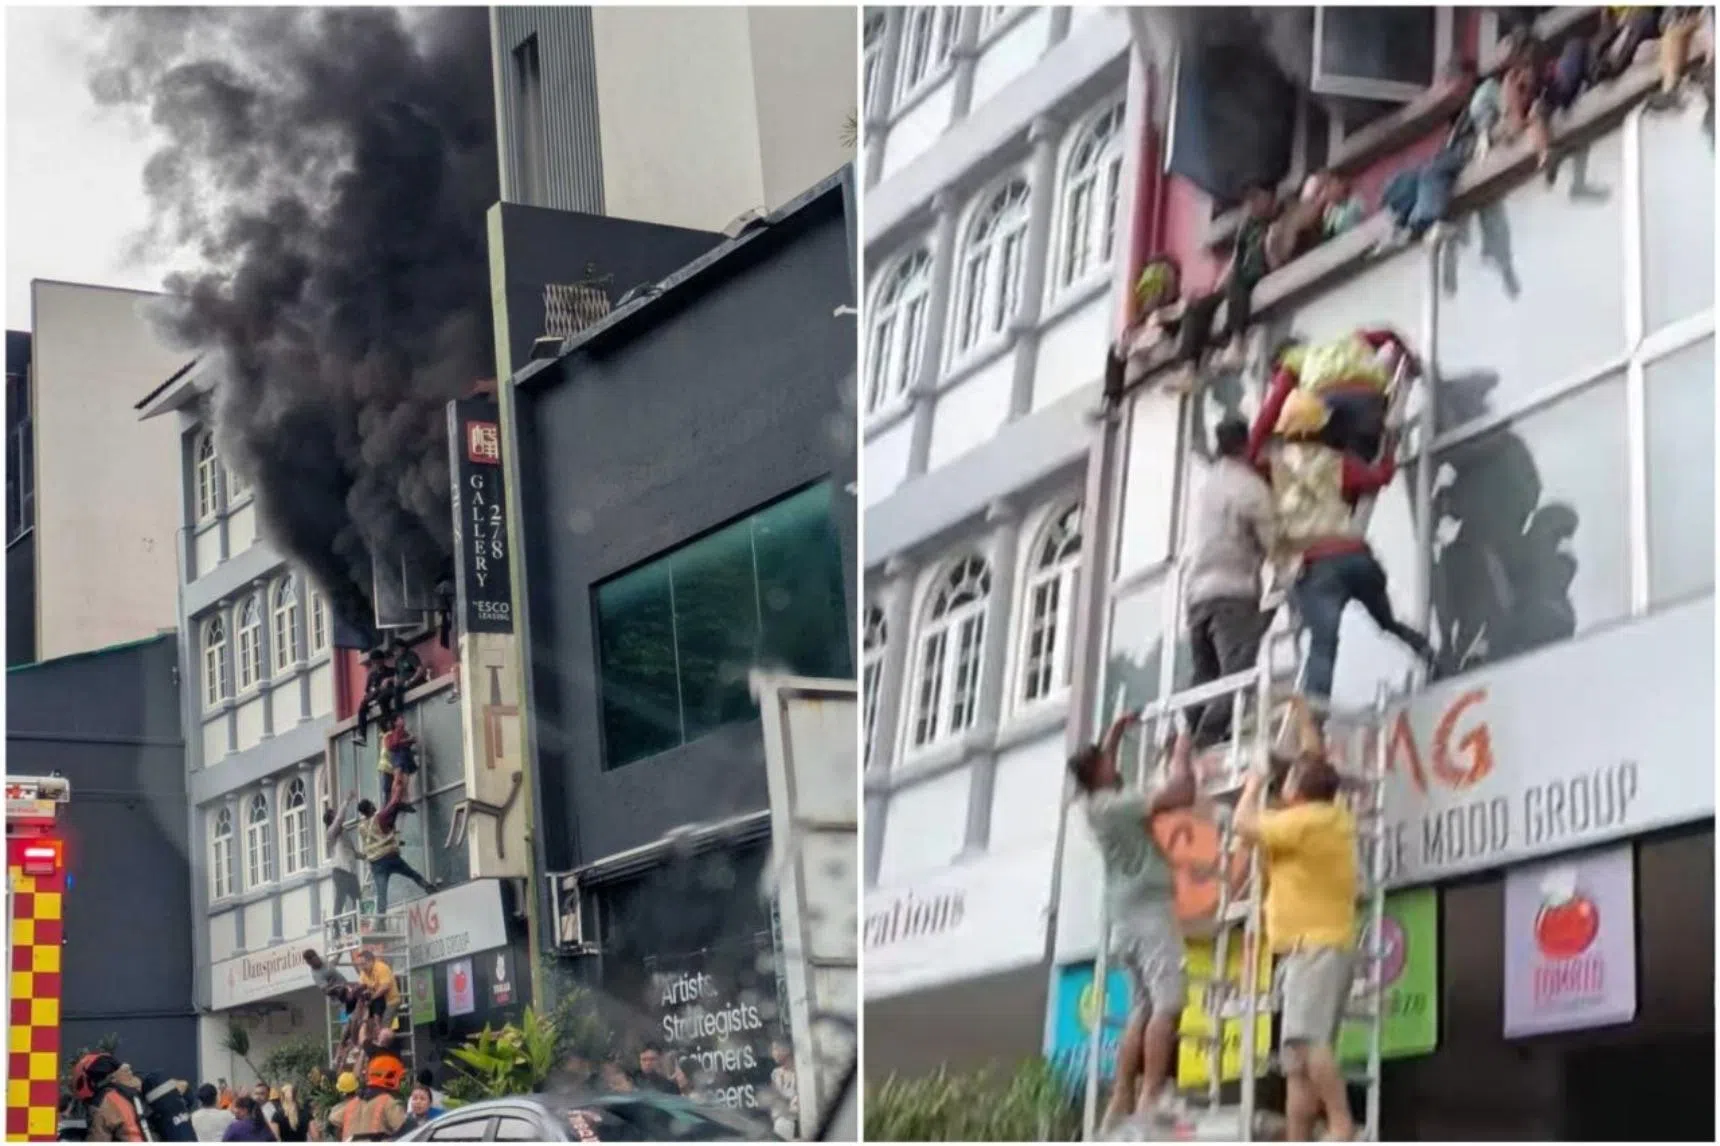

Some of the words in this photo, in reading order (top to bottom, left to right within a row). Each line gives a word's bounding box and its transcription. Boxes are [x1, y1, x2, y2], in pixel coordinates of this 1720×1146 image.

[470, 474, 488, 587] GALLERY
[490, 504, 503, 560] 278
[478, 600, 510, 614] ESCO
[1422, 797, 1509, 865] MOOD
[1524, 761, 1638, 846] GROUP
